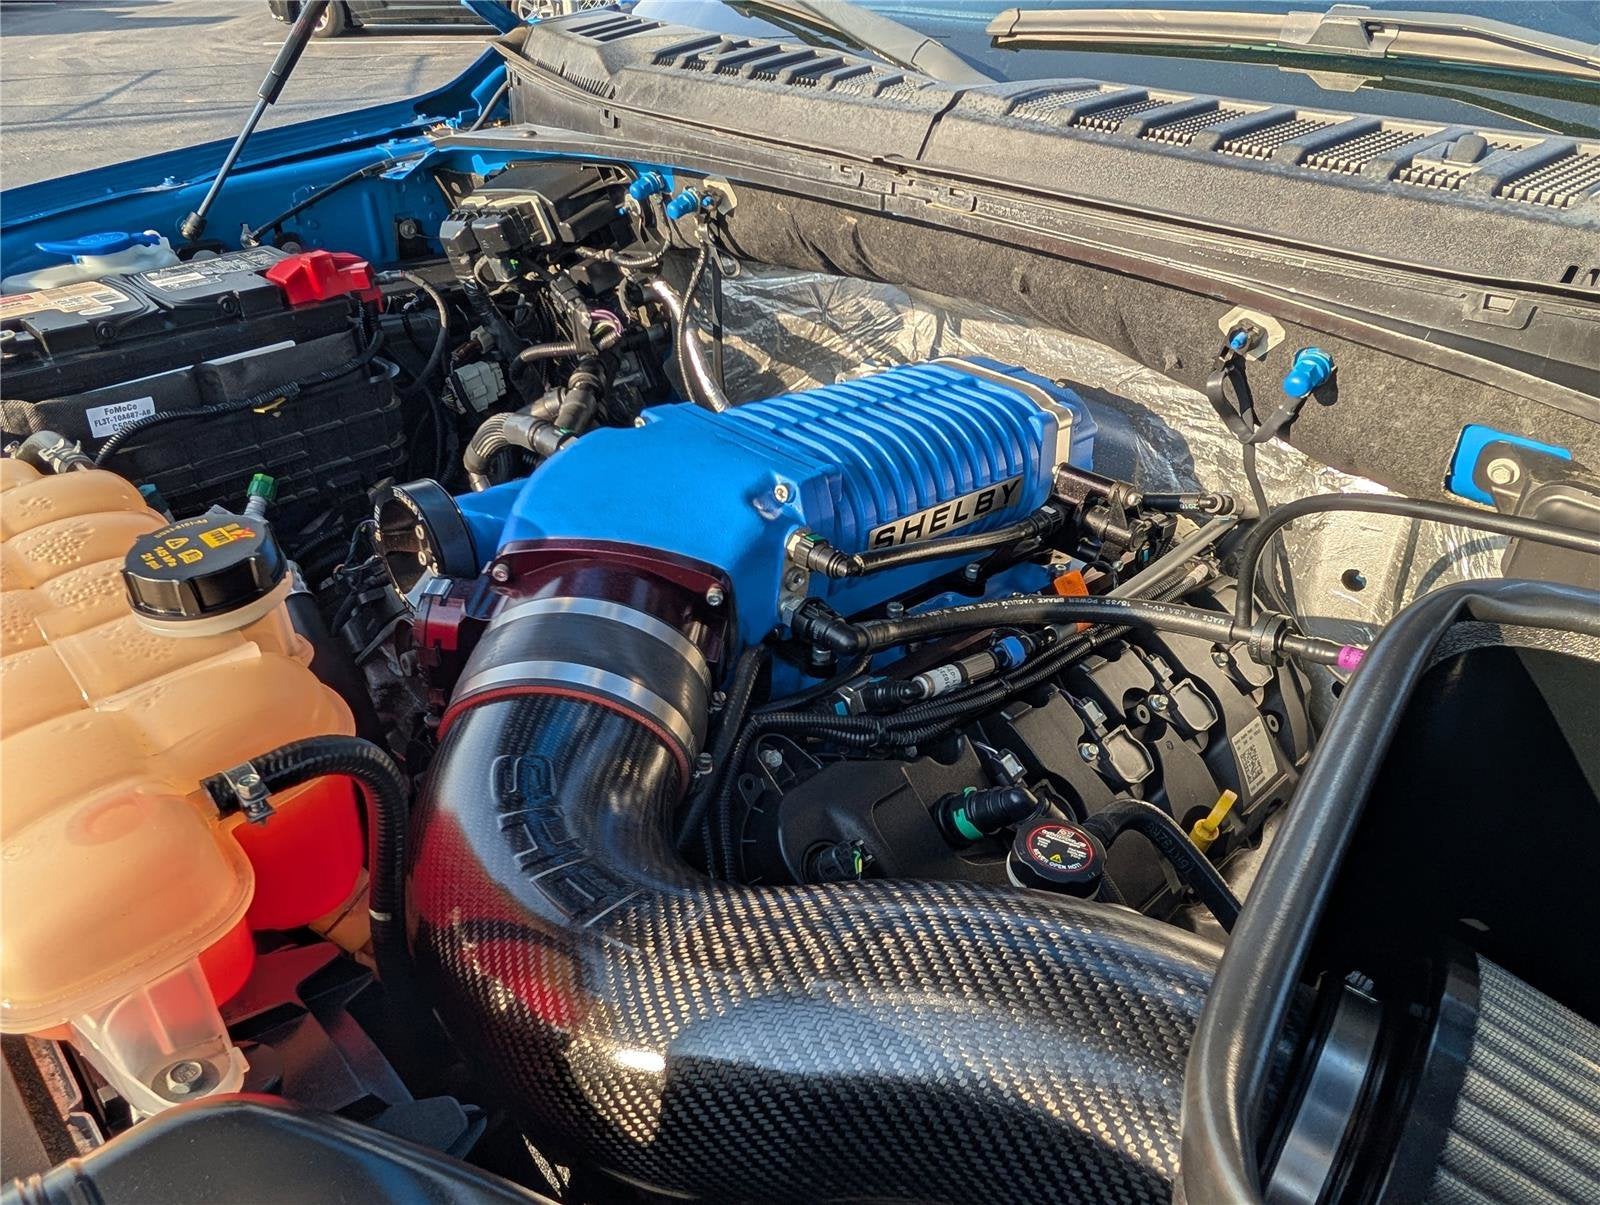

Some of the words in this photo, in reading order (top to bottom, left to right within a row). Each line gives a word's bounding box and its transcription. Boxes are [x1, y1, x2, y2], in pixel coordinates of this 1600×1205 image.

[103, 403, 137, 416] FoMoCo
[874, 478, 1021, 549] SHELBY
[954, 604, 976, 613] MADE
[1168, 607, 1187, 618] USA
[1202, 614, 1226, 626] MADE
[1049, 861, 1067, 870] OPEN
